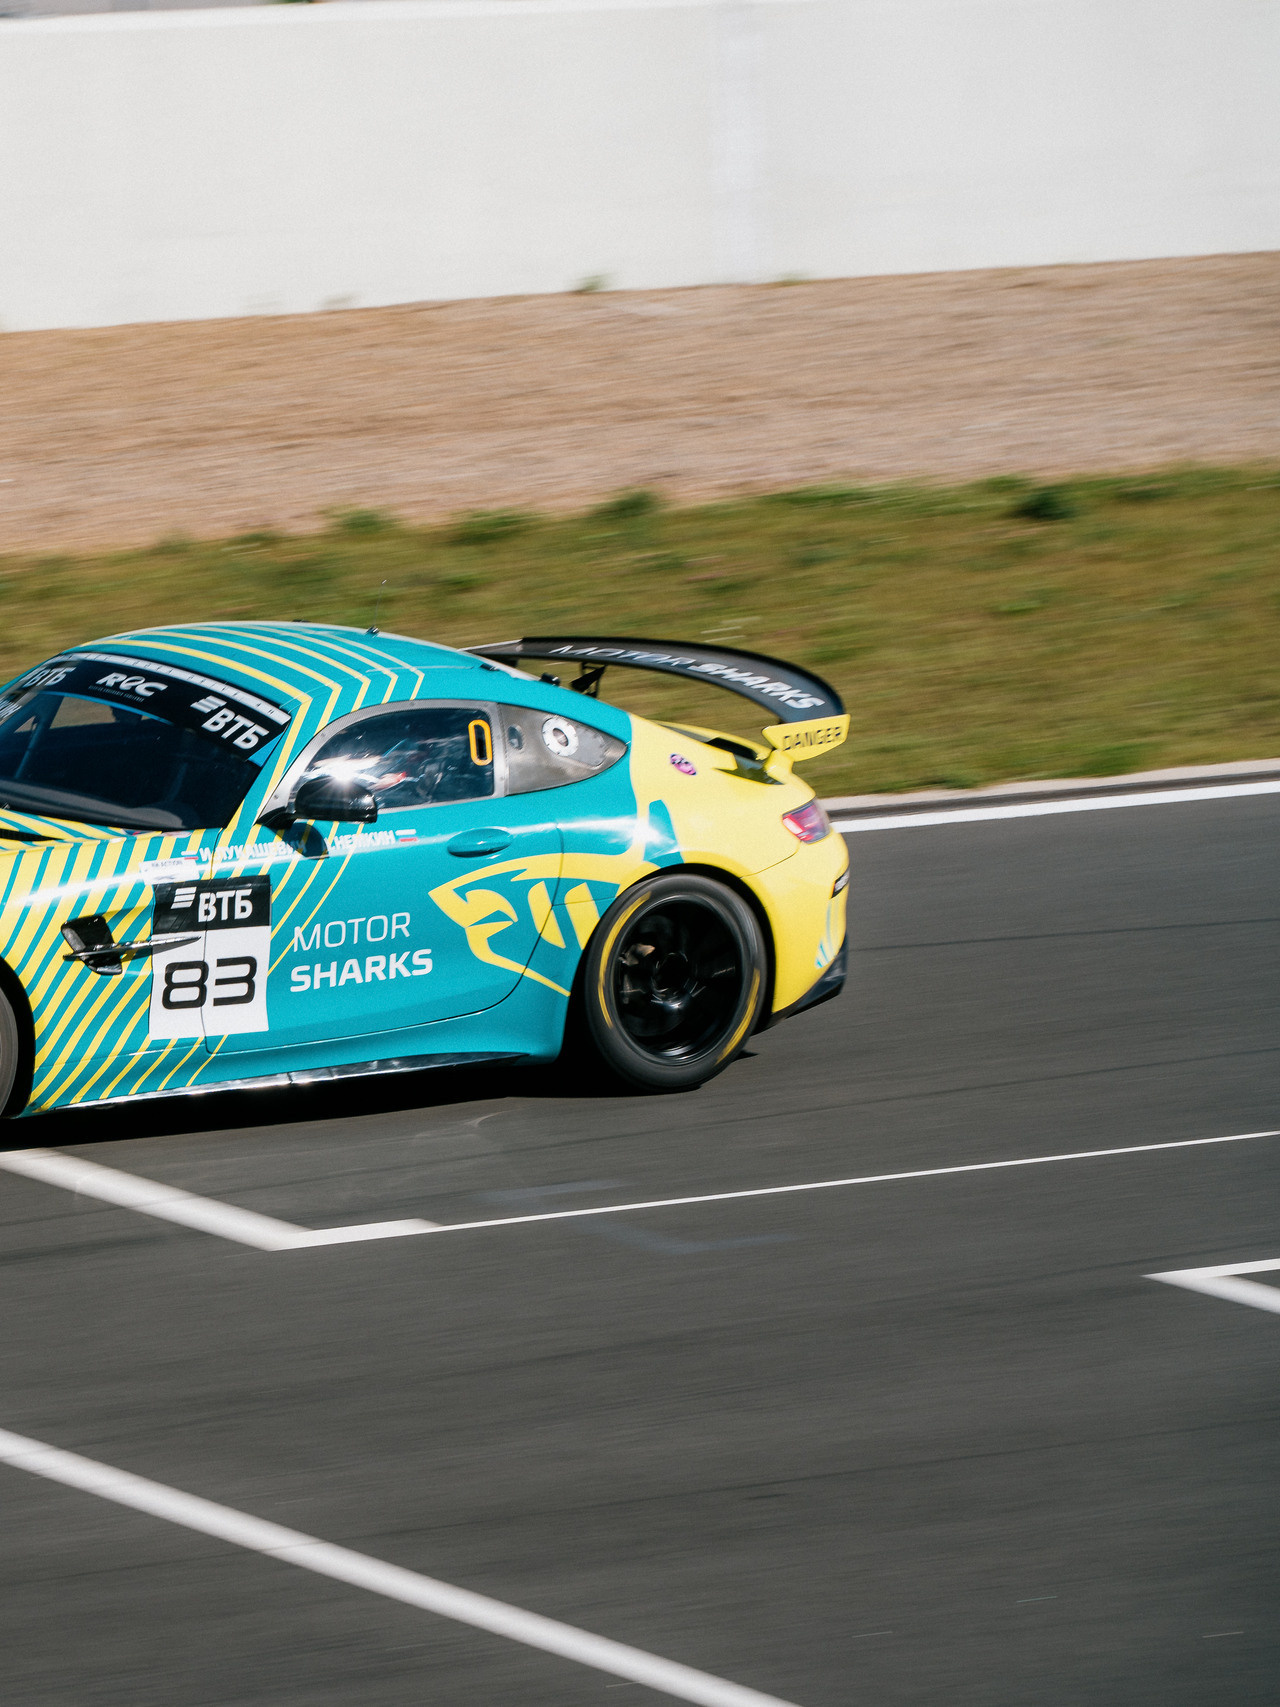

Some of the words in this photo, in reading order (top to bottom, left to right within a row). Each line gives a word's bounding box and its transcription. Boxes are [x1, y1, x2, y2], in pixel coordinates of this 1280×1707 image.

[688, 663, 826, 710] SHARKS
[201, 707, 270, 750] ВТБ
[783, 726, 842, 752] DANGER
[198, 888, 254, 923] ВТБ
[293, 911, 411, 953] MOTOR
[162, 955, 258, 1011] 83
[290, 948, 433, 993] SHARKS
